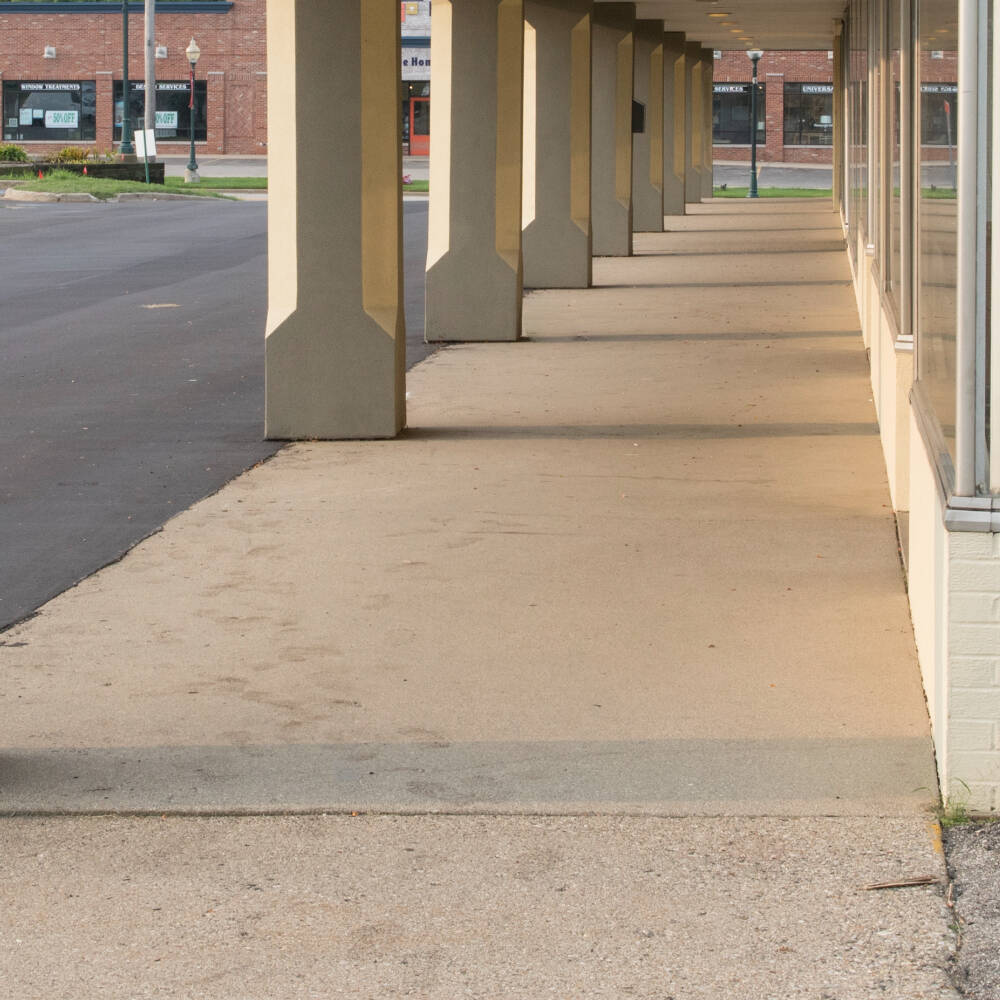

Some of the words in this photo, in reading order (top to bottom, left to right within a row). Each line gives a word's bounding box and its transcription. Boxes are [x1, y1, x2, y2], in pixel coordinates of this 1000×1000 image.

[21, 83, 43, 91] WINDOW
[44, 83, 80, 91] TREATMENTS
[159, 83, 187, 91] SERVICES
[714, 85, 744, 93] SERVICES
